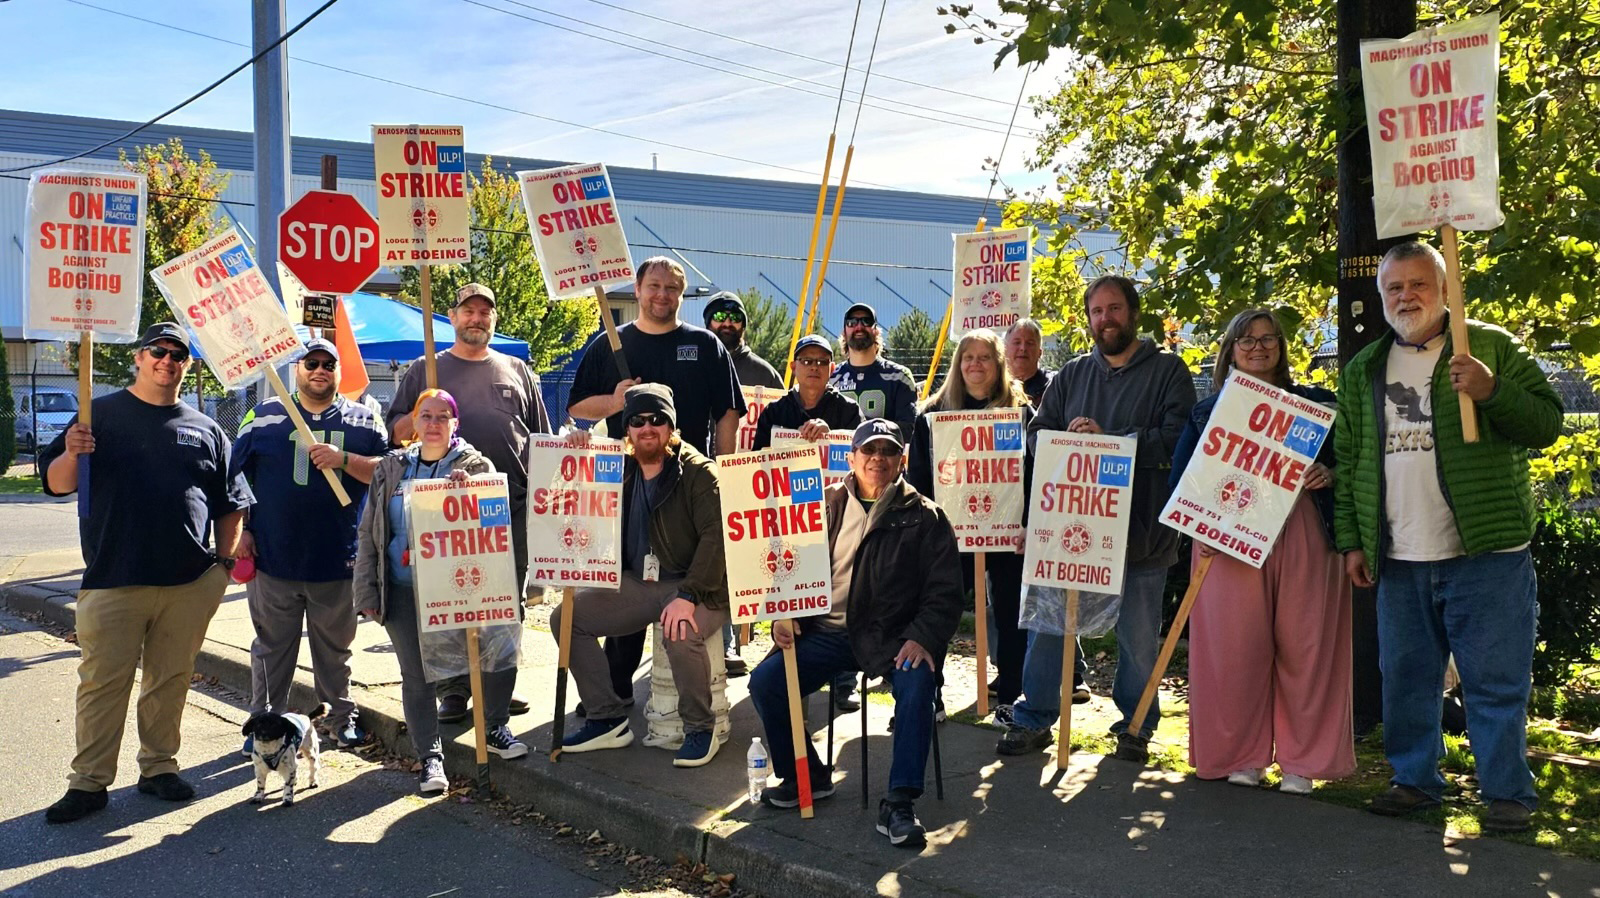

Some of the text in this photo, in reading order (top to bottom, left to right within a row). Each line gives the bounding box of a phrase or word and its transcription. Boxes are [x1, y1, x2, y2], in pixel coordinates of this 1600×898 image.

[1370, 34, 1488, 63] MACHINISTS UNION
[1410, 59, 1452, 98] ON
[1378, 94, 1485, 142] STRIKE
[404, 140, 437, 166] ON
[440, 152, 461, 163] ULP!
[1410, 138, 1457, 158] AGAINST
[39, 175, 136, 189] MACHINISTS UNION
[526, 172, 562, 182] AEROSPACE
[1393, 155, 1475, 187] Boeing
[380, 173, 463, 198] STRIKE
[553, 179, 586, 204] ON
[585, 180, 606, 192] ULP!
[69, 192, 103, 220] ON
[112, 203, 131, 211] LABOR
[538, 202, 616, 236] STRIKE
[40, 222, 131, 254] STRIKE
[200, 234, 236, 259] MACHINISTS
[286, 221, 375, 263] STOP
[63, 256, 107, 268] AGAINST
[224, 251, 244, 267] ULP!
[387, 249, 466, 260] AT BOEING
[602, 258, 626, 266] AFL-CIO
[980, 244, 1003, 264] ON
[1006, 246, 1025, 255] ULP!
[48, 268, 121, 294] Boeing
[194, 257, 229, 288] ON
[554, 267, 576, 275] LODGE
[559, 268, 631, 290] AT BOEING
[962, 263, 1020, 286] STRIKE
[188, 272, 266, 328] STRIKE
[963, 316, 976, 329] AT
[246, 337, 297, 368] BOEING
[1234, 375, 1332, 421] AEROSPACE MACHINISTS
[747, 402, 764, 425] O
[936, 414, 975, 422] AEROSPACE
[1248, 403, 1295, 443] ON
[536, 441, 577, 449] AEROSPAC
[961, 426, 994, 451] ON
[996, 429, 1019, 440] ULP!
[1051, 439, 1120, 450] AEROSPACE MACHINISTS
[1292, 424, 1321, 446] ULP!
[1386, 429, 1433, 454] EXIC
[598, 462, 620, 473] ULP!
[721, 448, 816, 467] AEROSPACE MACHINISTS
[818, 445, 829, 469] N
[831, 451, 848, 461] ULP
[1203, 426, 1306, 492] STRIKE
[561, 455, 594, 482] ON
[938, 458, 1020, 485] STRIKE
[1066, 452, 1099, 484] ON
[1102, 462, 1127, 476] ULP!
[414, 479, 504, 492] AEROSPACE MACHINISTS
[752, 467, 791, 500] ON
[793, 476, 819, 492] ULP!
[443, 494, 479, 522] ON
[481, 504, 506, 517] ULP!
[534, 487, 618, 517] STRIKE
[1040, 482, 1120, 518] STRIKE
[1177, 497, 1222, 521] LODGE 751
[727, 501, 823, 542] STRIKE
[1234, 523, 1268, 542] AFL-CIO
[419, 526, 509, 559] STRIKE
[1168, 510, 1263, 561] AT BOEING
[536, 569, 617, 582] AT BOEING
[1035, 560, 1112, 586] AT BOEING
[735, 586, 781, 597] LODGE 751
[794, 581, 825, 591] AFL-CIO
[481, 595, 512, 604] AFL-CIO
[737, 595, 828, 617] AT BOEING
[428, 608, 515, 626] AT BOEING
